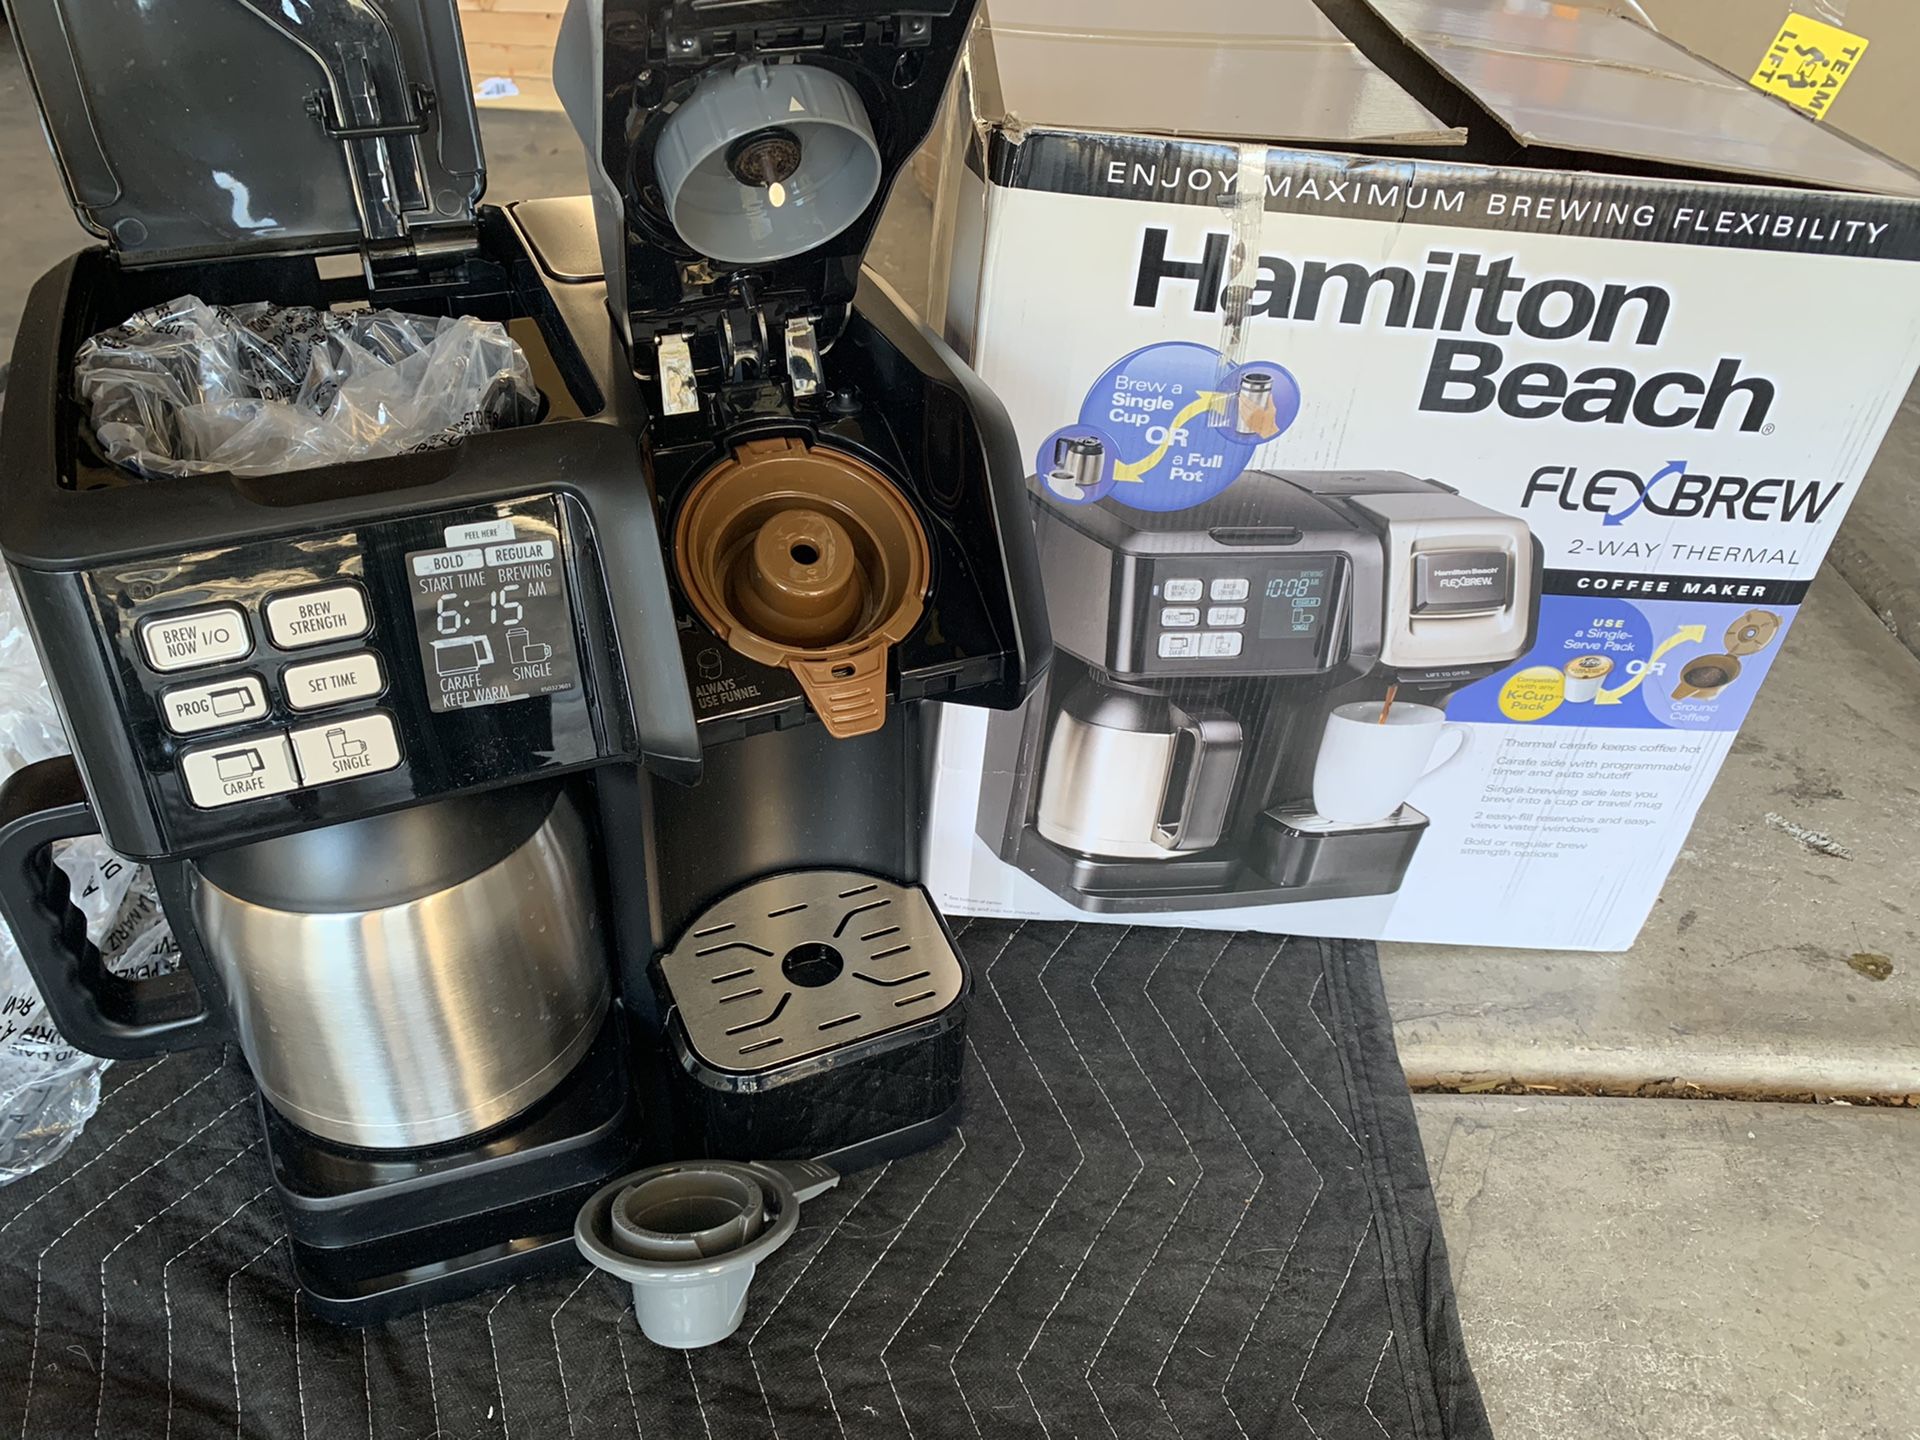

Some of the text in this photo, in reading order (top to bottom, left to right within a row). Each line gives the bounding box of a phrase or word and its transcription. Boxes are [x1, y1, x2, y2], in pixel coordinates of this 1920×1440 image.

[1758, 30, 1798, 83] LIFT
[1808, 47, 1860, 110] TEAM
[1107, 161, 1889, 244] ENJOY MAXIMUM BREWING FLEXIBILITY
[1133, 227, 1671, 346] Hamilton
[1115, 375, 1183, 394] Brew a
[1112, 392, 1174, 411] Single
[1109, 408, 1150, 426] Cup
[1145, 426, 1189, 447] OR
[1172, 453, 1223, 468] a Full
[1169, 467, 1204, 482] Pot
[1521, 462, 1844, 524] FLEXBREW
[465, 528, 498, 541] PEEL HERE
[496, 545, 544, 562] REGULAR
[1568, 539, 1800, 565] 2-WAY THERMAL
[434, 555, 464, 570] BOLD
[498, 563, 552, 584] BREWING
[1434, 568, 1471, 577] Hamilton
[420, 571, 486, 594] START TIME
[1266, 578, 1310, 598] 10:08
[1577, 577, 1766, 598] COFFEE MAKER
[299, 601, 332, 618] BREW
[437, 582, 547, 634] 6:15 AM
[290, 613, 348, 636] STRENGTH
[1592, 618, 1625, 628] USE
[163, 626, 198, 644] BREW
[1574, 628, 1634, 641] a Single-
[167, 642, 198, 658] NOW
[1564, 640, 1636, 652] Serve Pack
[513, 663, 552, 681] SINGLE
[1626, 660, 1666, 676] OR
[308, 672, 358, 693] SET TIME
[440, 673, 482, 693] CARAFE
[696, 678, 736, 698] ALWAYS
[442, 685, 511, 708] KEEP WARM
[698, 685, 761, 708] USE FUNNEL
[176, 699, 210, 718] PROG
[1510, 701, 1546, 712] Pack
[1671, 702, 1719, 713] Ground
[1670, 712, 1710, 722] Coffee
[1504, 738, 1702, 754] Thermal carafe keeps coffee hot
[332, 754, 372, 774] SINGLE
[1496, 756, 1692, 772] Carafe side with programmable
[1492, 768, 1632, 780] timer and auto shutoff
[224, 777, 266, 796] CARAFE
[1486, 784, 1658, 800] Single brewing side lets you
[1480, 794, 1514, 804] brew
[1516, 796, 1540, 805] into
[1554, 800, 1578, 808] cup
[1598, 800, 1631, 808] travel
[1634, 802, 1663, 810] mug
[1470, 822, 1600, 834] view water windows
[1474, 811, 1657, 827] 2 easy-fill reservoirs and easy-
[1464, 837, 1588, 850] Bold or regular brew
[1460, 848, 1560, 860] strength options
[108, 910, 142, 951] NARIZ
